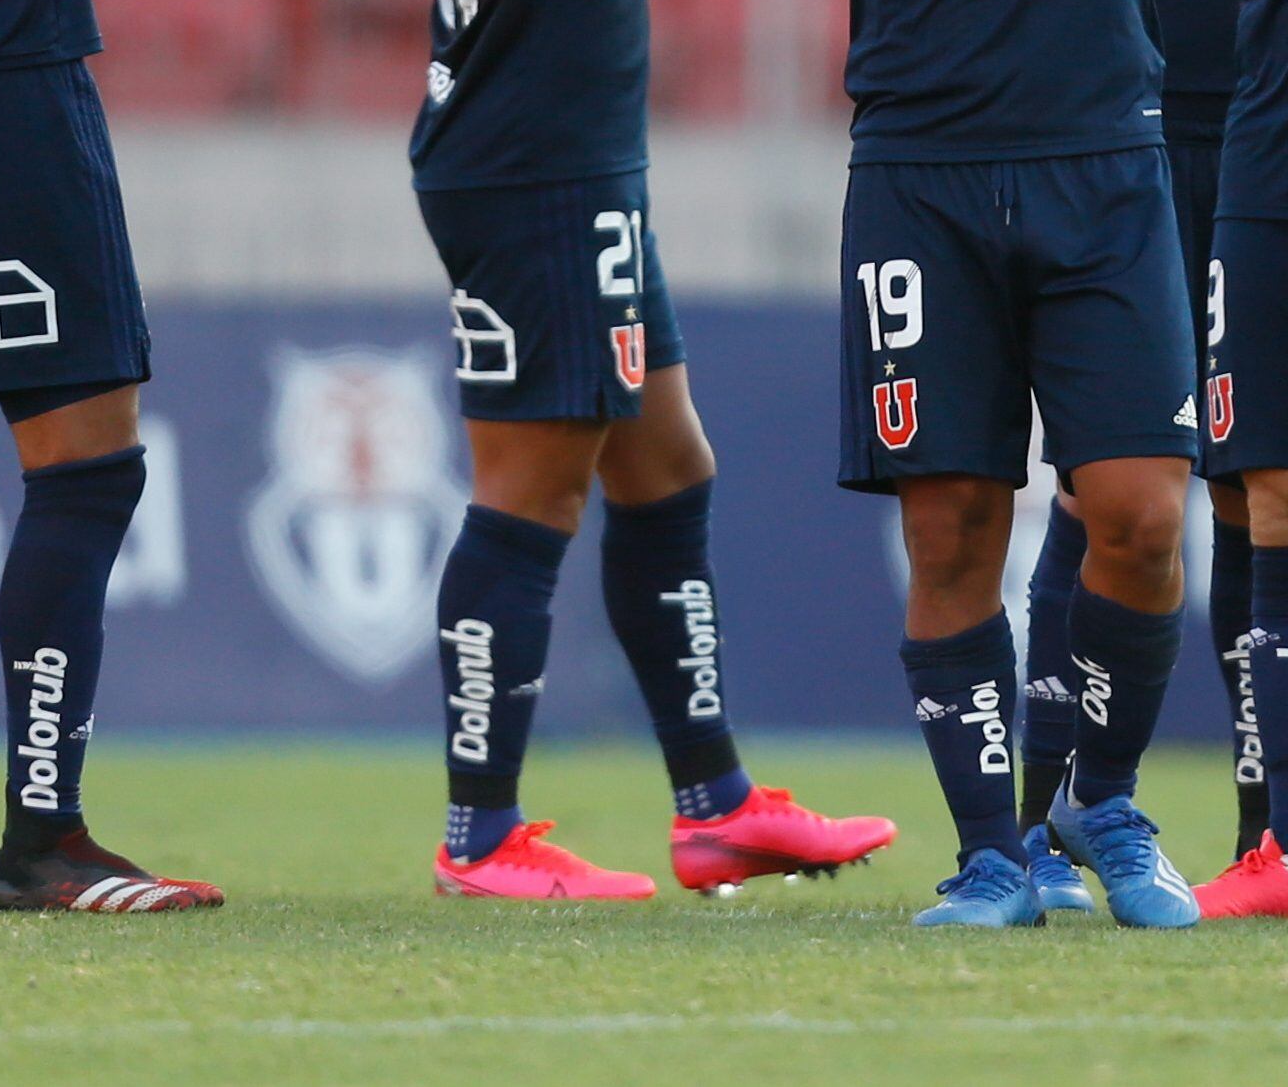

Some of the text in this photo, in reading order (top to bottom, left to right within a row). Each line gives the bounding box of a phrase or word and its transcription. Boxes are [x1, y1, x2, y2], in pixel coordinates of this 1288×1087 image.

[594, 209, 644, 296] 21
[857, 258, 924, 352] 19
[610, 322, 646, 392] U
[873, 378, 918, 450] U
[1207, 373, 1235, 444] U
[440, 618, 495, 762] Dolorub
[660, 579, 722, 718] Dolorub
[13, 647, 69, 811] Dolorub
